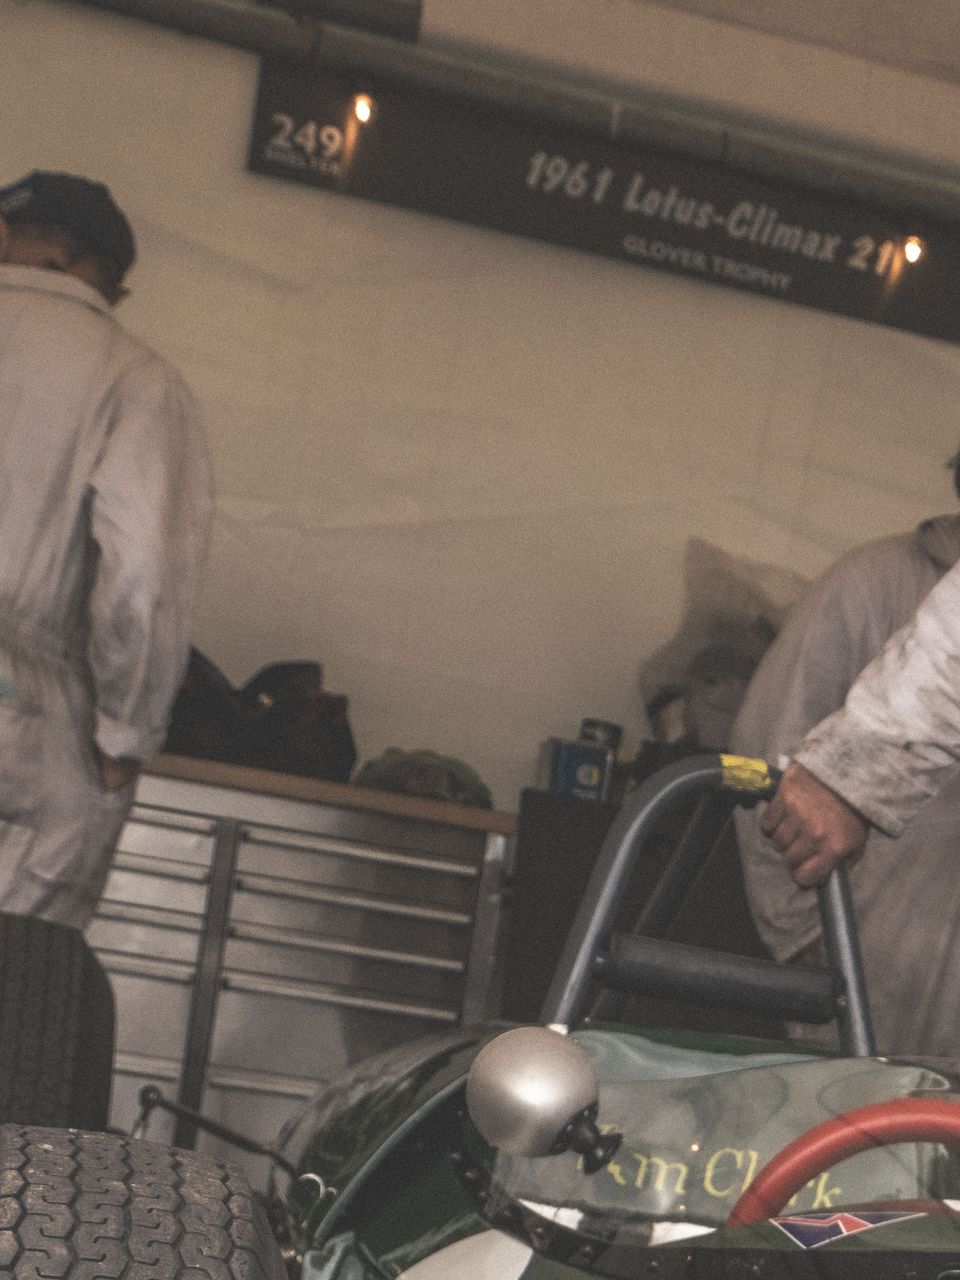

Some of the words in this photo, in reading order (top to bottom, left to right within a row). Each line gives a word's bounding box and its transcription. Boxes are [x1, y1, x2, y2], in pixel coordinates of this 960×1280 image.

[269, 112, 342, 158] 249
[527, 151, 614, 205] 1961
[623, 172, 843, 263] Lotus-Climax
